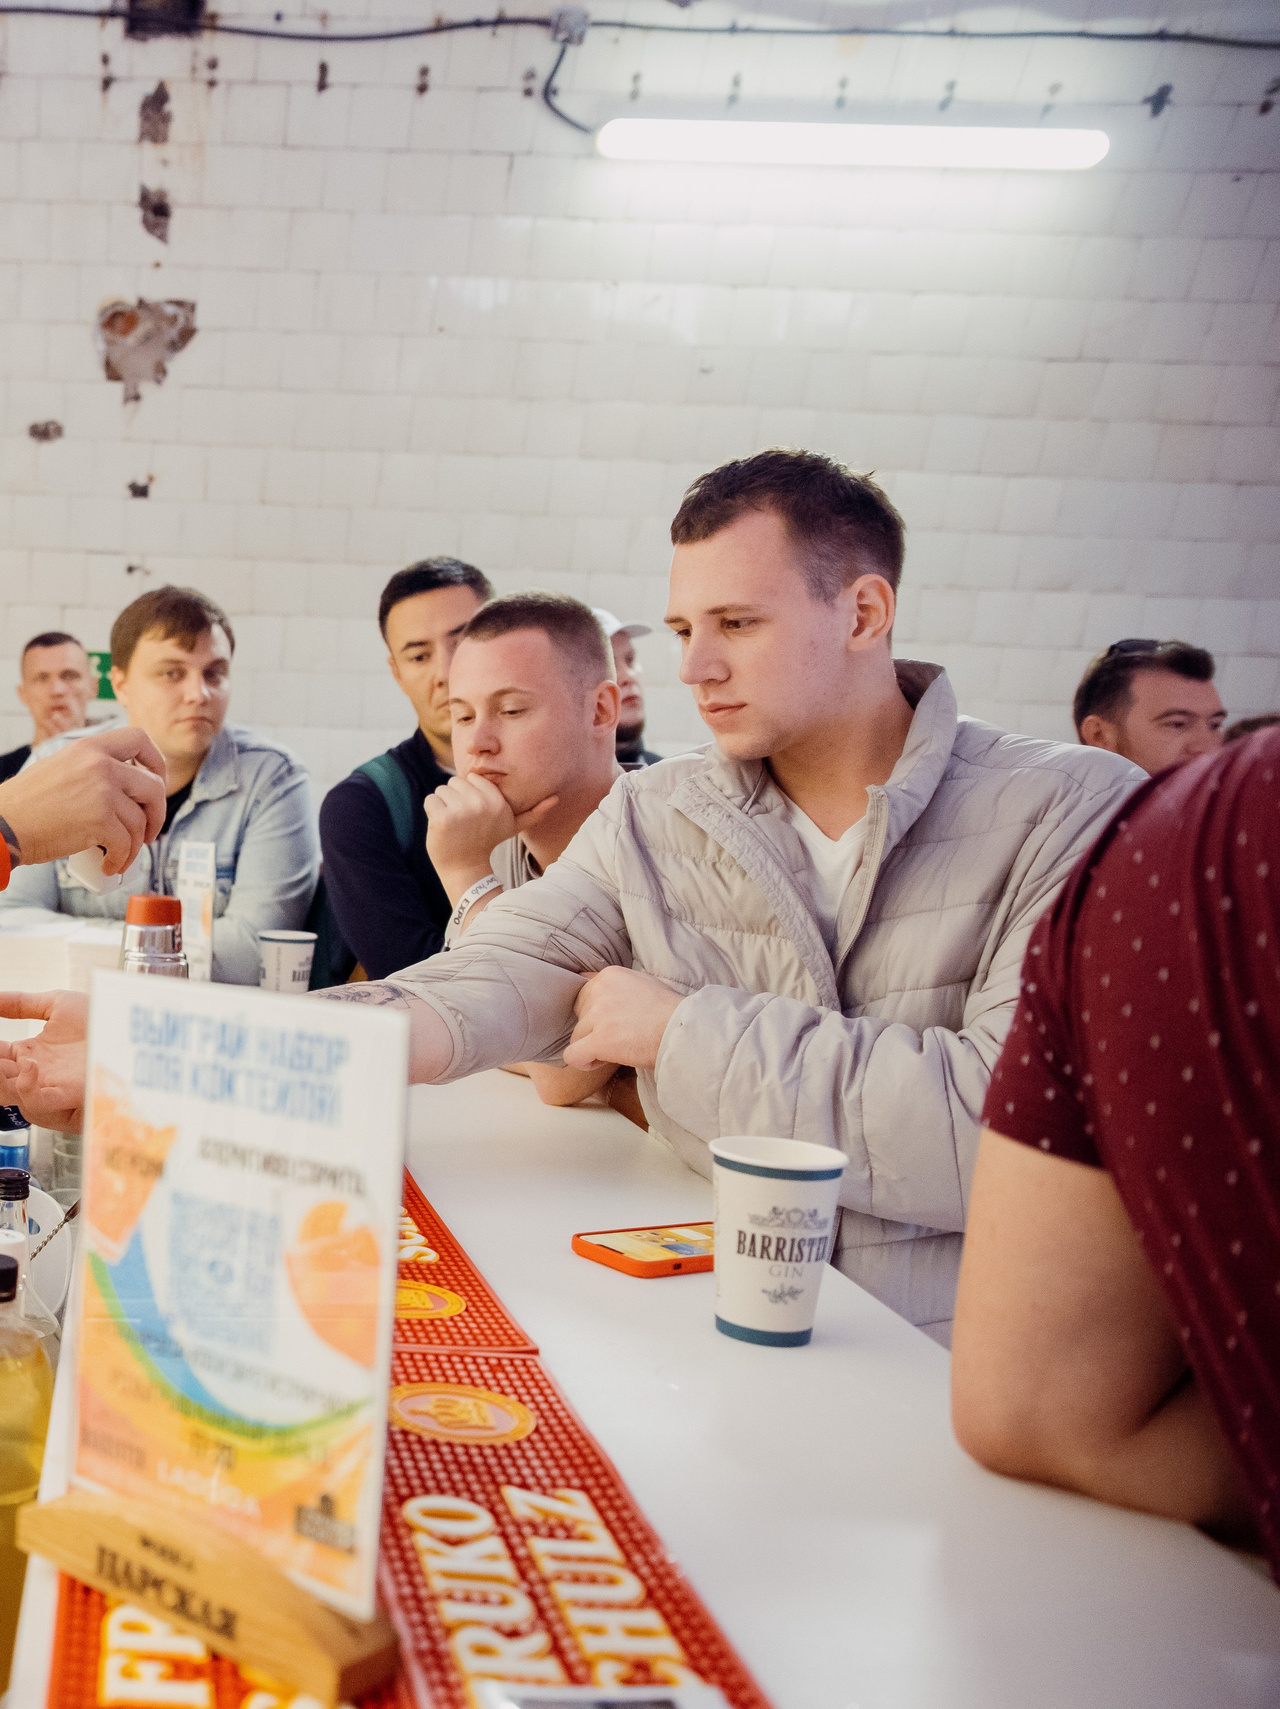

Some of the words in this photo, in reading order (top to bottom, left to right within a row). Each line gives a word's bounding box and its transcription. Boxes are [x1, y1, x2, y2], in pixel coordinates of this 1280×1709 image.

[453, 898, 470, 926] EXPO
[736, 1229, 830, 1264] BARRISTE
[769, 1264, 805, 1279] GIN
[402, 1495, 568, 1690] RUKO
